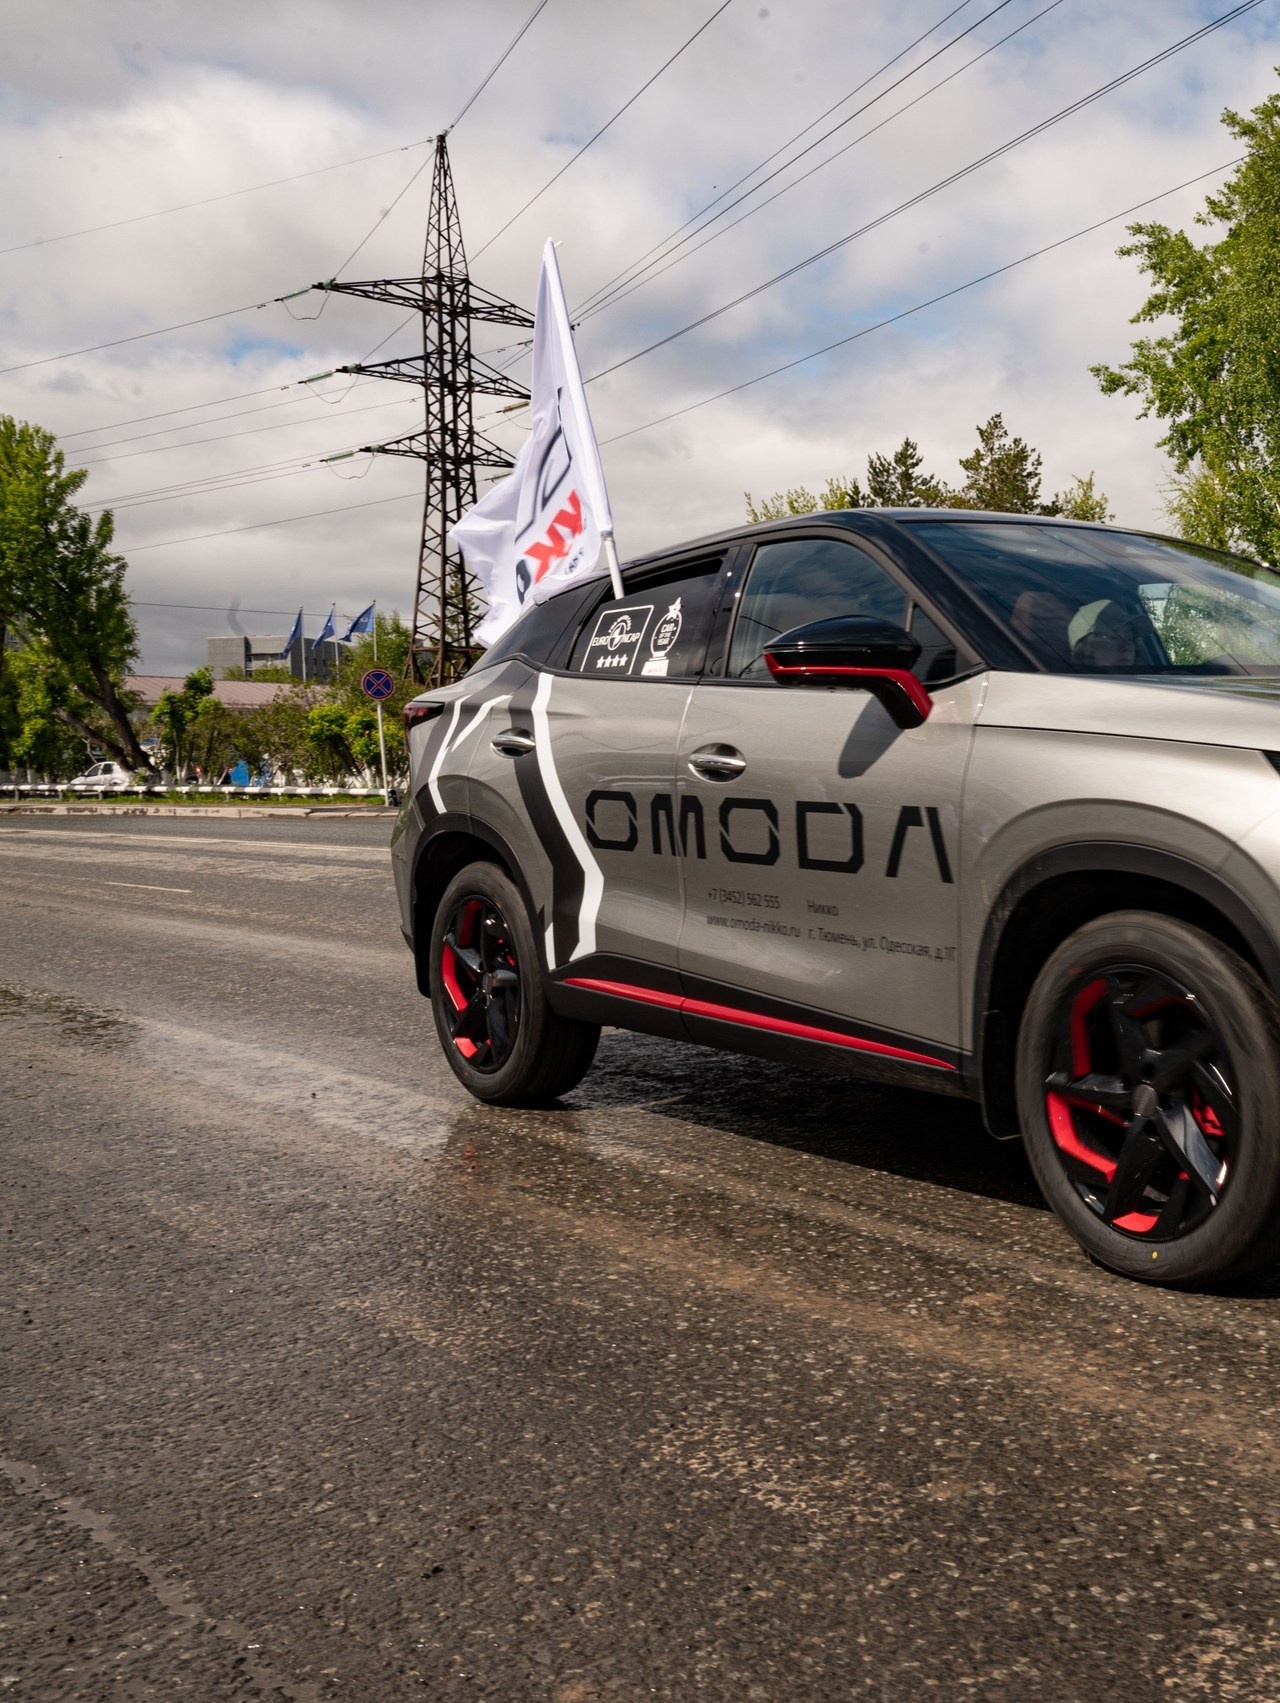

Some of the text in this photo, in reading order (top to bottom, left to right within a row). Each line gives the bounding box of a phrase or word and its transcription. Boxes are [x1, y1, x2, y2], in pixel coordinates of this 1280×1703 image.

[591, 636, 610, 646] EURO
[585, 789, 955, 885] OMODA
[707, 888, 781, 909] +7 (3452) 562 555
[806, 899, 839, 917] Никко
[706, 914, 801, 938] www.omoda-nikko.ru
[817, 927, 861, 949] Тюмень,
